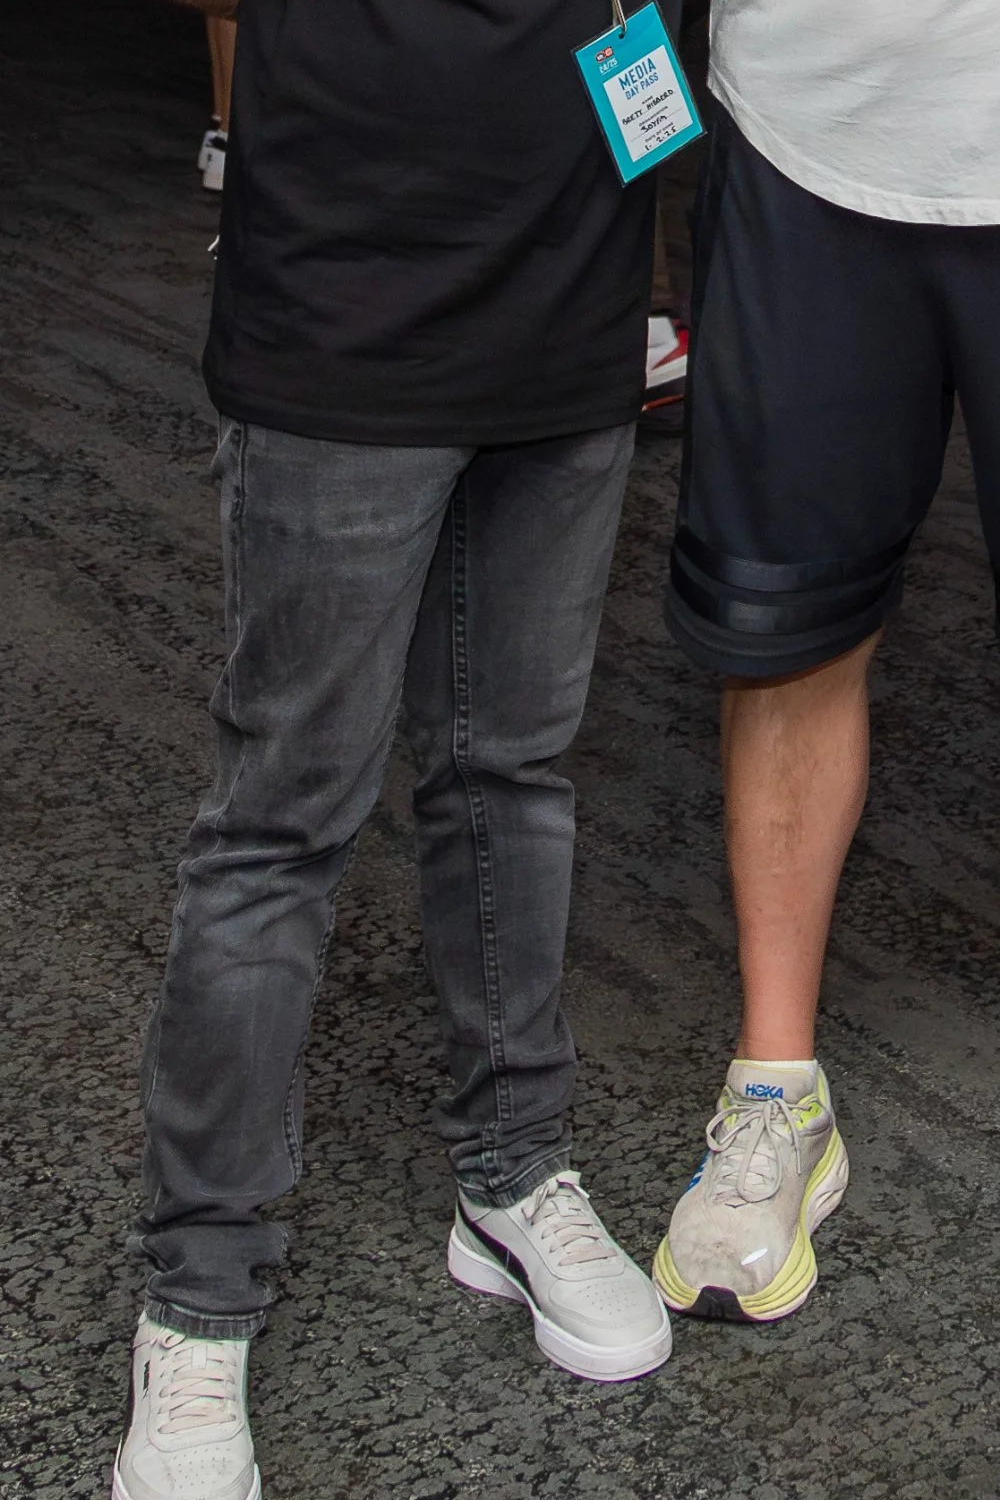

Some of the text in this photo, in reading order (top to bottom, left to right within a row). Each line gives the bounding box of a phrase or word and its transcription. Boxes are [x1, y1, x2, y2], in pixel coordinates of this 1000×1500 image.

[618, 57, 657, 91] MEDIA
[625, 72, 659, 101] DAY PASS
[745, 1083, 785, 1099] HOKA
